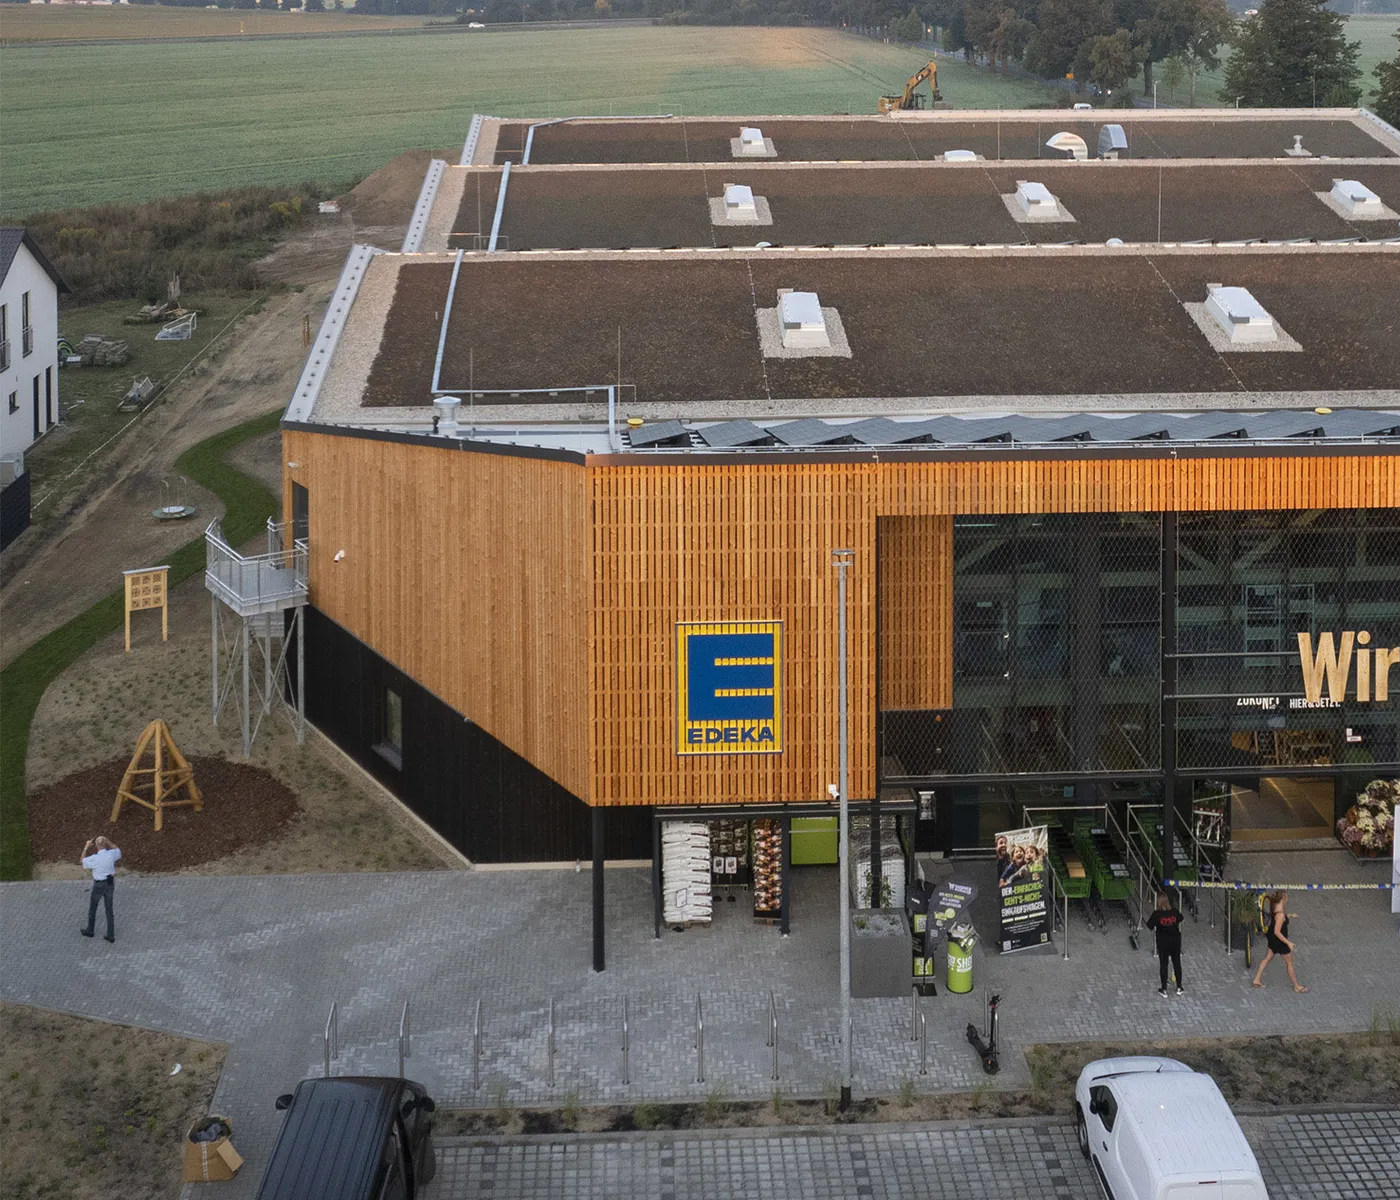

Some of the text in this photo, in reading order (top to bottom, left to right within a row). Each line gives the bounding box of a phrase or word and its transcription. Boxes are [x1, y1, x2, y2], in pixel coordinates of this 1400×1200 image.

[687, 632, 775, 722] E
[1297, 630, 1400, 702] Wir
[687, 726, 775, 745] EDEKA
[1178, 880, 1200, 888] EDEKA
